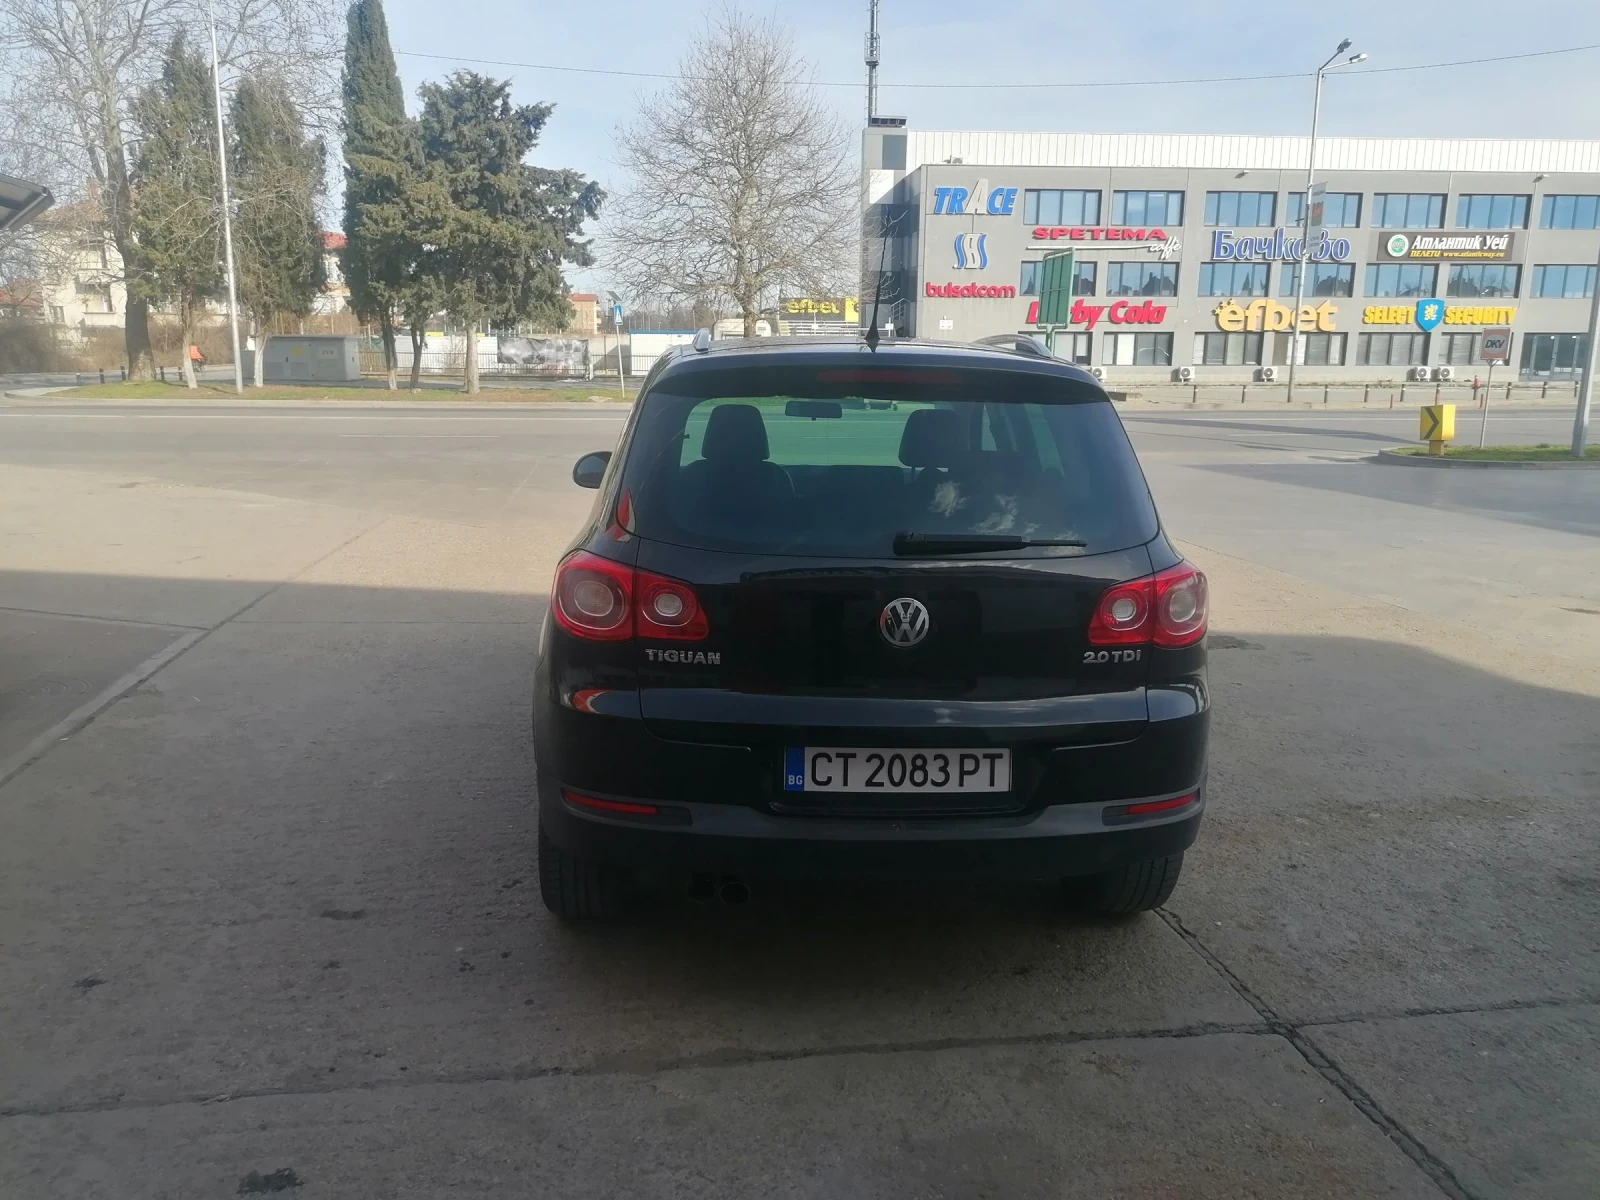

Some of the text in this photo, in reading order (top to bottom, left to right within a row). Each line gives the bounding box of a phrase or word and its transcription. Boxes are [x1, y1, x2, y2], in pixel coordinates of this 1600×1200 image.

[934, 179, 1018, 215] TRACE
[1032, 227, 1168, 241] SPETEMA
[1411, 234, 1509, 250] Атлантик Уей
[926, 282, 1016, 298] bulsatcom
[1110, 300, 1168, 325] Cola
[1214, 298, 1338, 332] efbet
[1363, 305, 1517, 326] SELECT SECURITY
[1484, 339, 1506, 349] DKV
[645, 648, 721, 665] TIGUAN
[864, 753, 951, 788] 2083
[788, 775, 803, 785] BG
